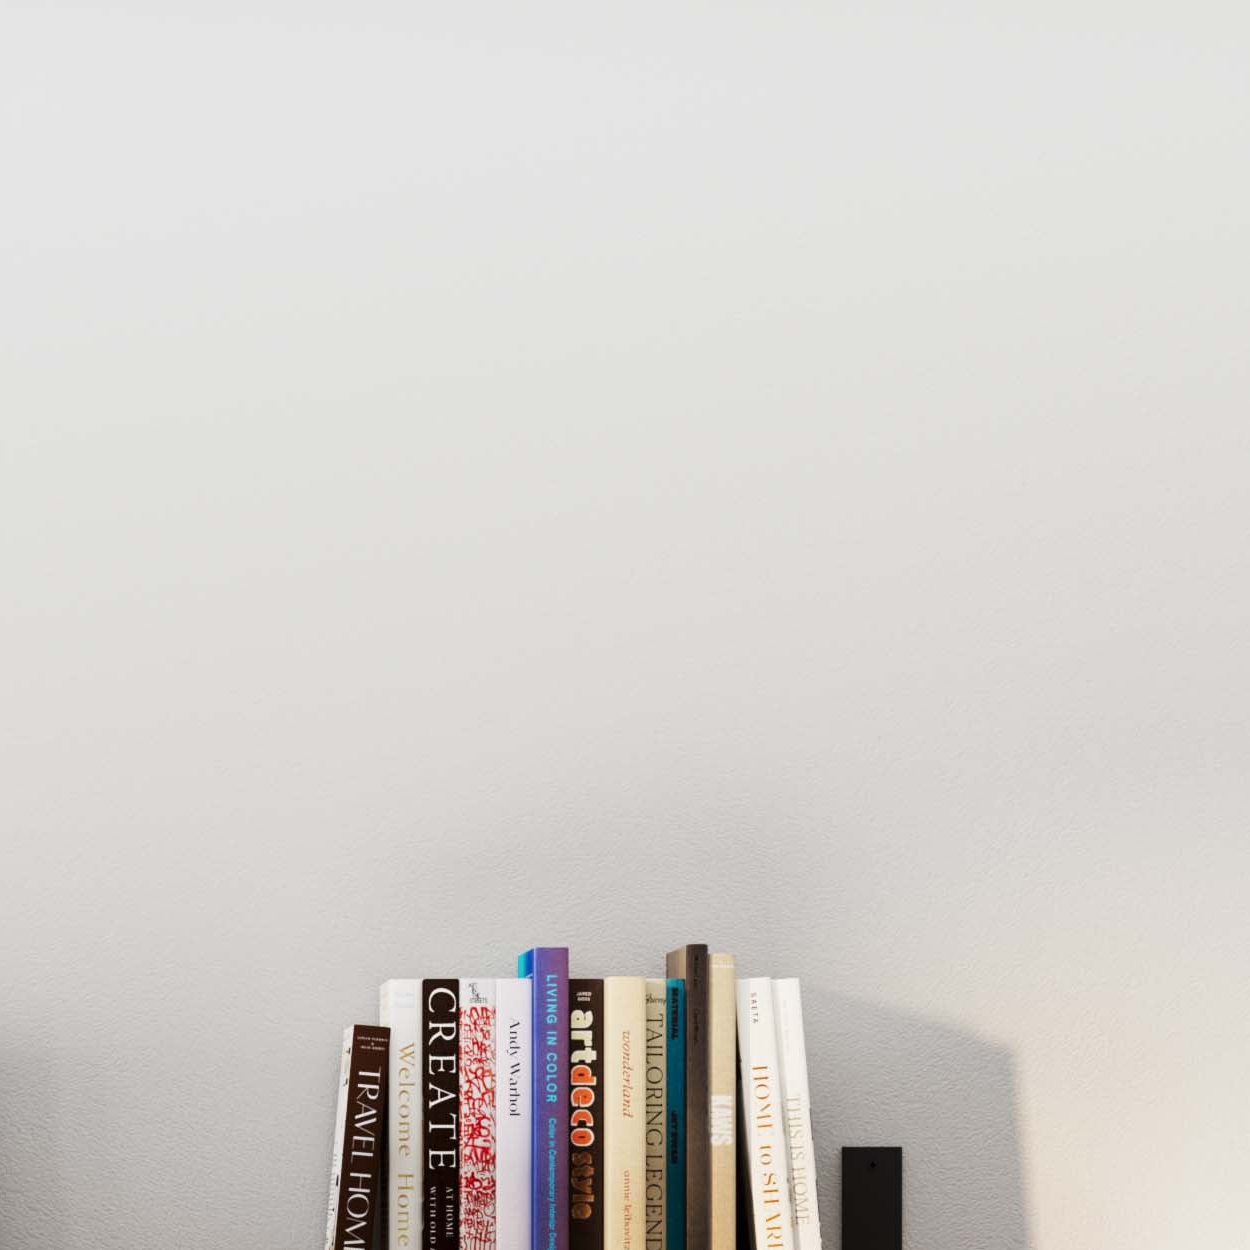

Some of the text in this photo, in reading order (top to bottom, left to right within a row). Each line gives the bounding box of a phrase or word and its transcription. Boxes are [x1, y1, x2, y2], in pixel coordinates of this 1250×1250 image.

[428, 987, 457, 1170] CREATE
[507, 1020, 521, 1117] Andy Warhol
[546, 974, 558, 1103] LIVING IN COLOR
[621, 1029, 634, 1120] wonderland
[646, 1013, 664, 1146] TAILORING
[350, 1066, 382, 1165] TRAVEL
[397, 1043, 415, 1248] Welcome Home
[786, 1098, 811, 1226] THIS IS HOME
[429, 1186, 437, 1214] WITH
[429, 1221, 437, 1245] OLD
[445, 1186, 455, 1238] AT HOME
[571, 1151, 595, 1220] style
